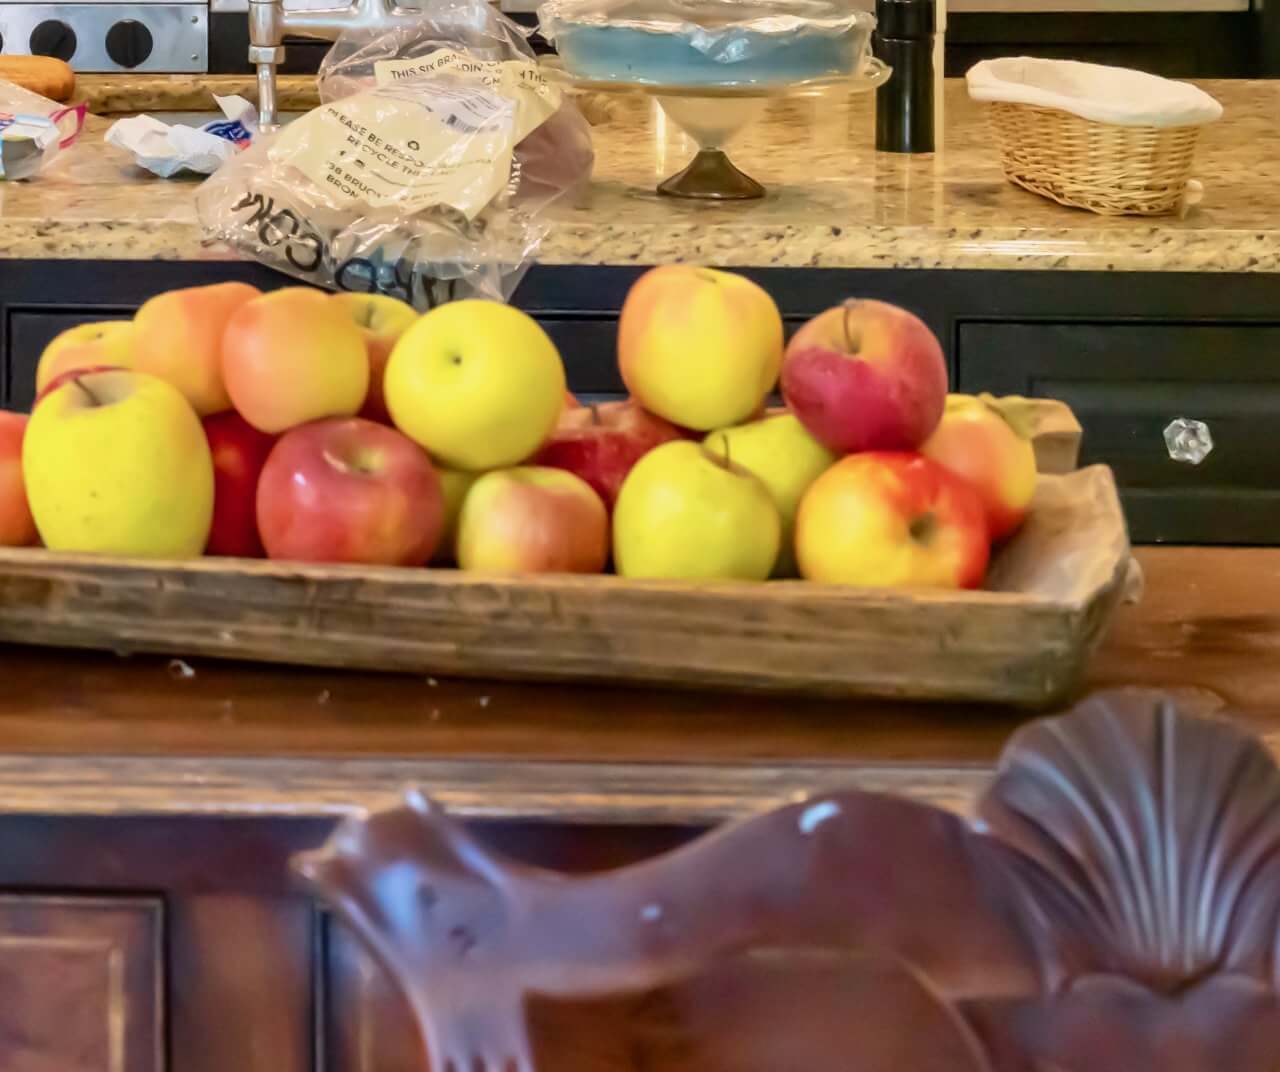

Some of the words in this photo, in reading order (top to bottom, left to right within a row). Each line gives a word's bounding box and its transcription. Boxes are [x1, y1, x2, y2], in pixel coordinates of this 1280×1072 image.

[391, 67, 416, 80] THIS
[419, 63, 436, 73] SIX
[367, 132, 384, 147] BE
